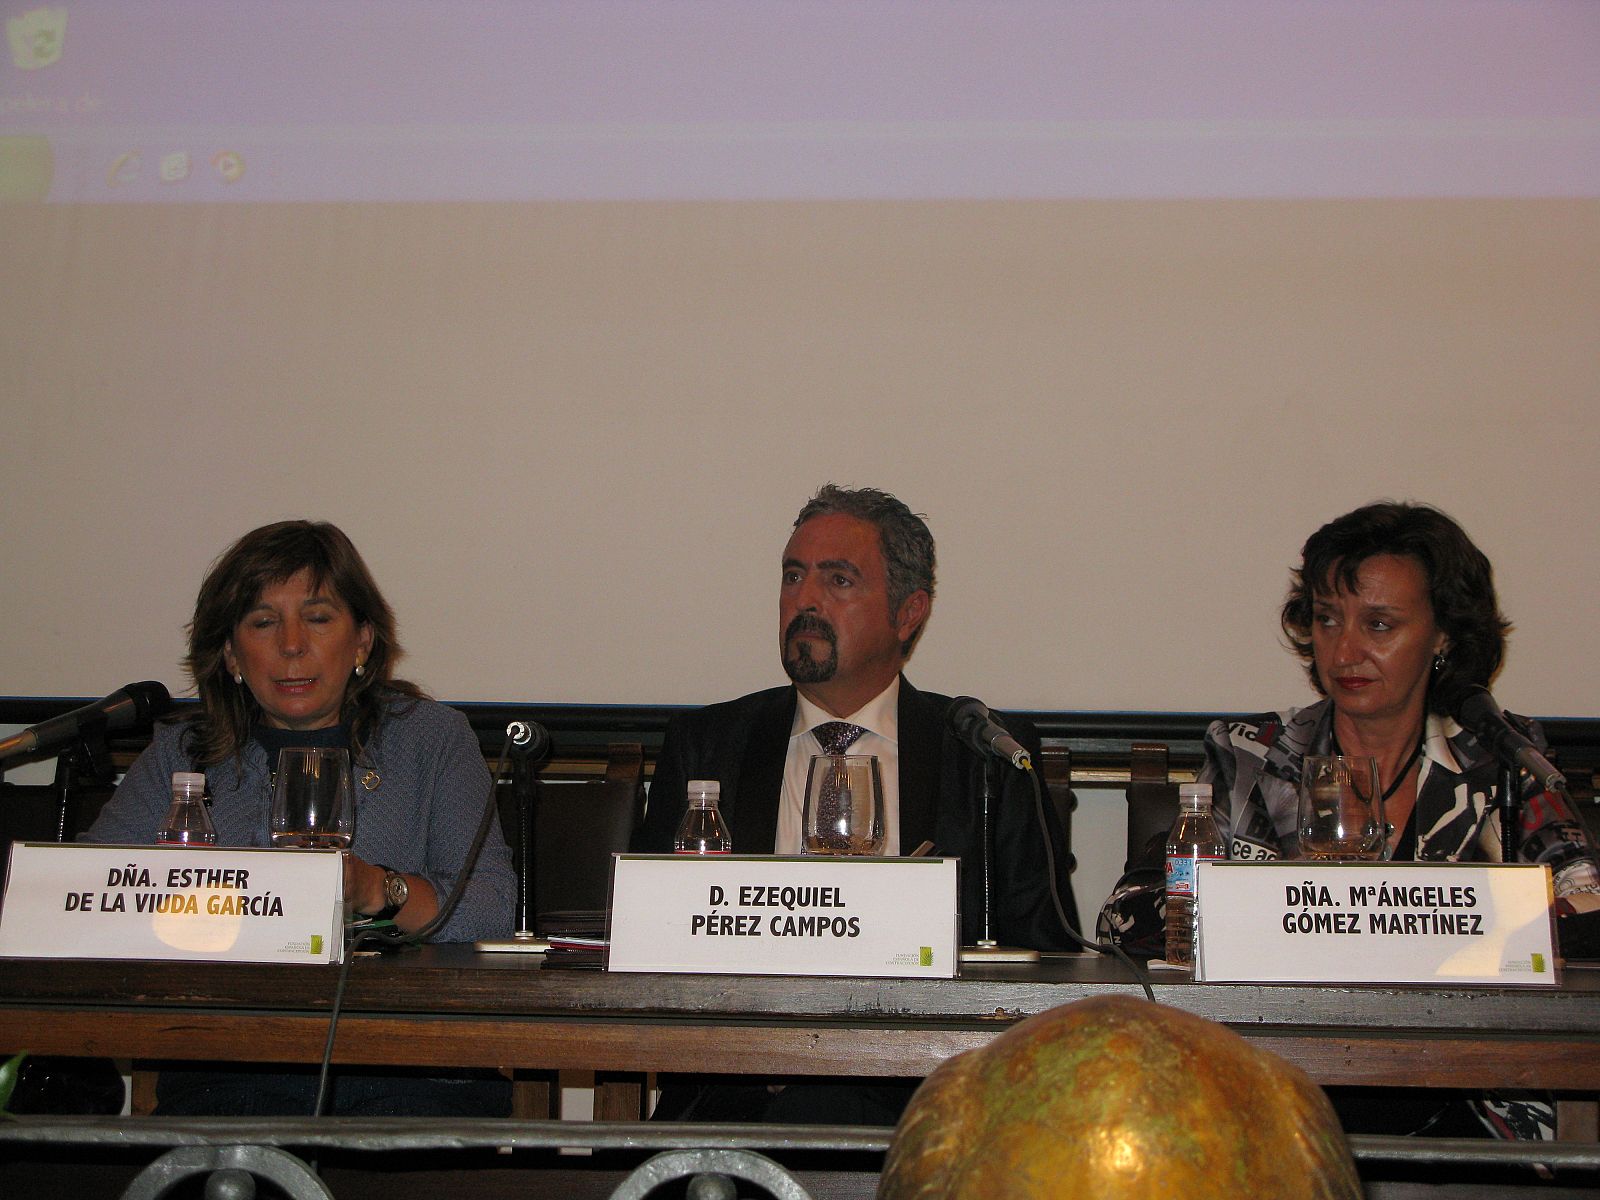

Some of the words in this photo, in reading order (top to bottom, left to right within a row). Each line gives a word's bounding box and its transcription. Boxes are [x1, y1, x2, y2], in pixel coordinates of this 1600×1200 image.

[107, 864, 157, 888] DÑA.
[167, 868, 249, 889] ESTHER
[65, 893, 94, 912] DE
[100, 894, 126, 913] LA
[136, 894, 199, 915] VIUDA
[206, 891, 284, 917] GARCÍA
[709, 886, 729, 907] D.
[738, 886, 846, 911] EZEQUIEL
[1285, 881, 1341, 907] DÑA.
[691, 910, 762, 936] PÉREZ
[769, 916, 861, 937] CAMPOS
[1282, 908, 1362, 934] GÓMEZ
[1369, 909, 1485, 936] MARTÍNEZ
